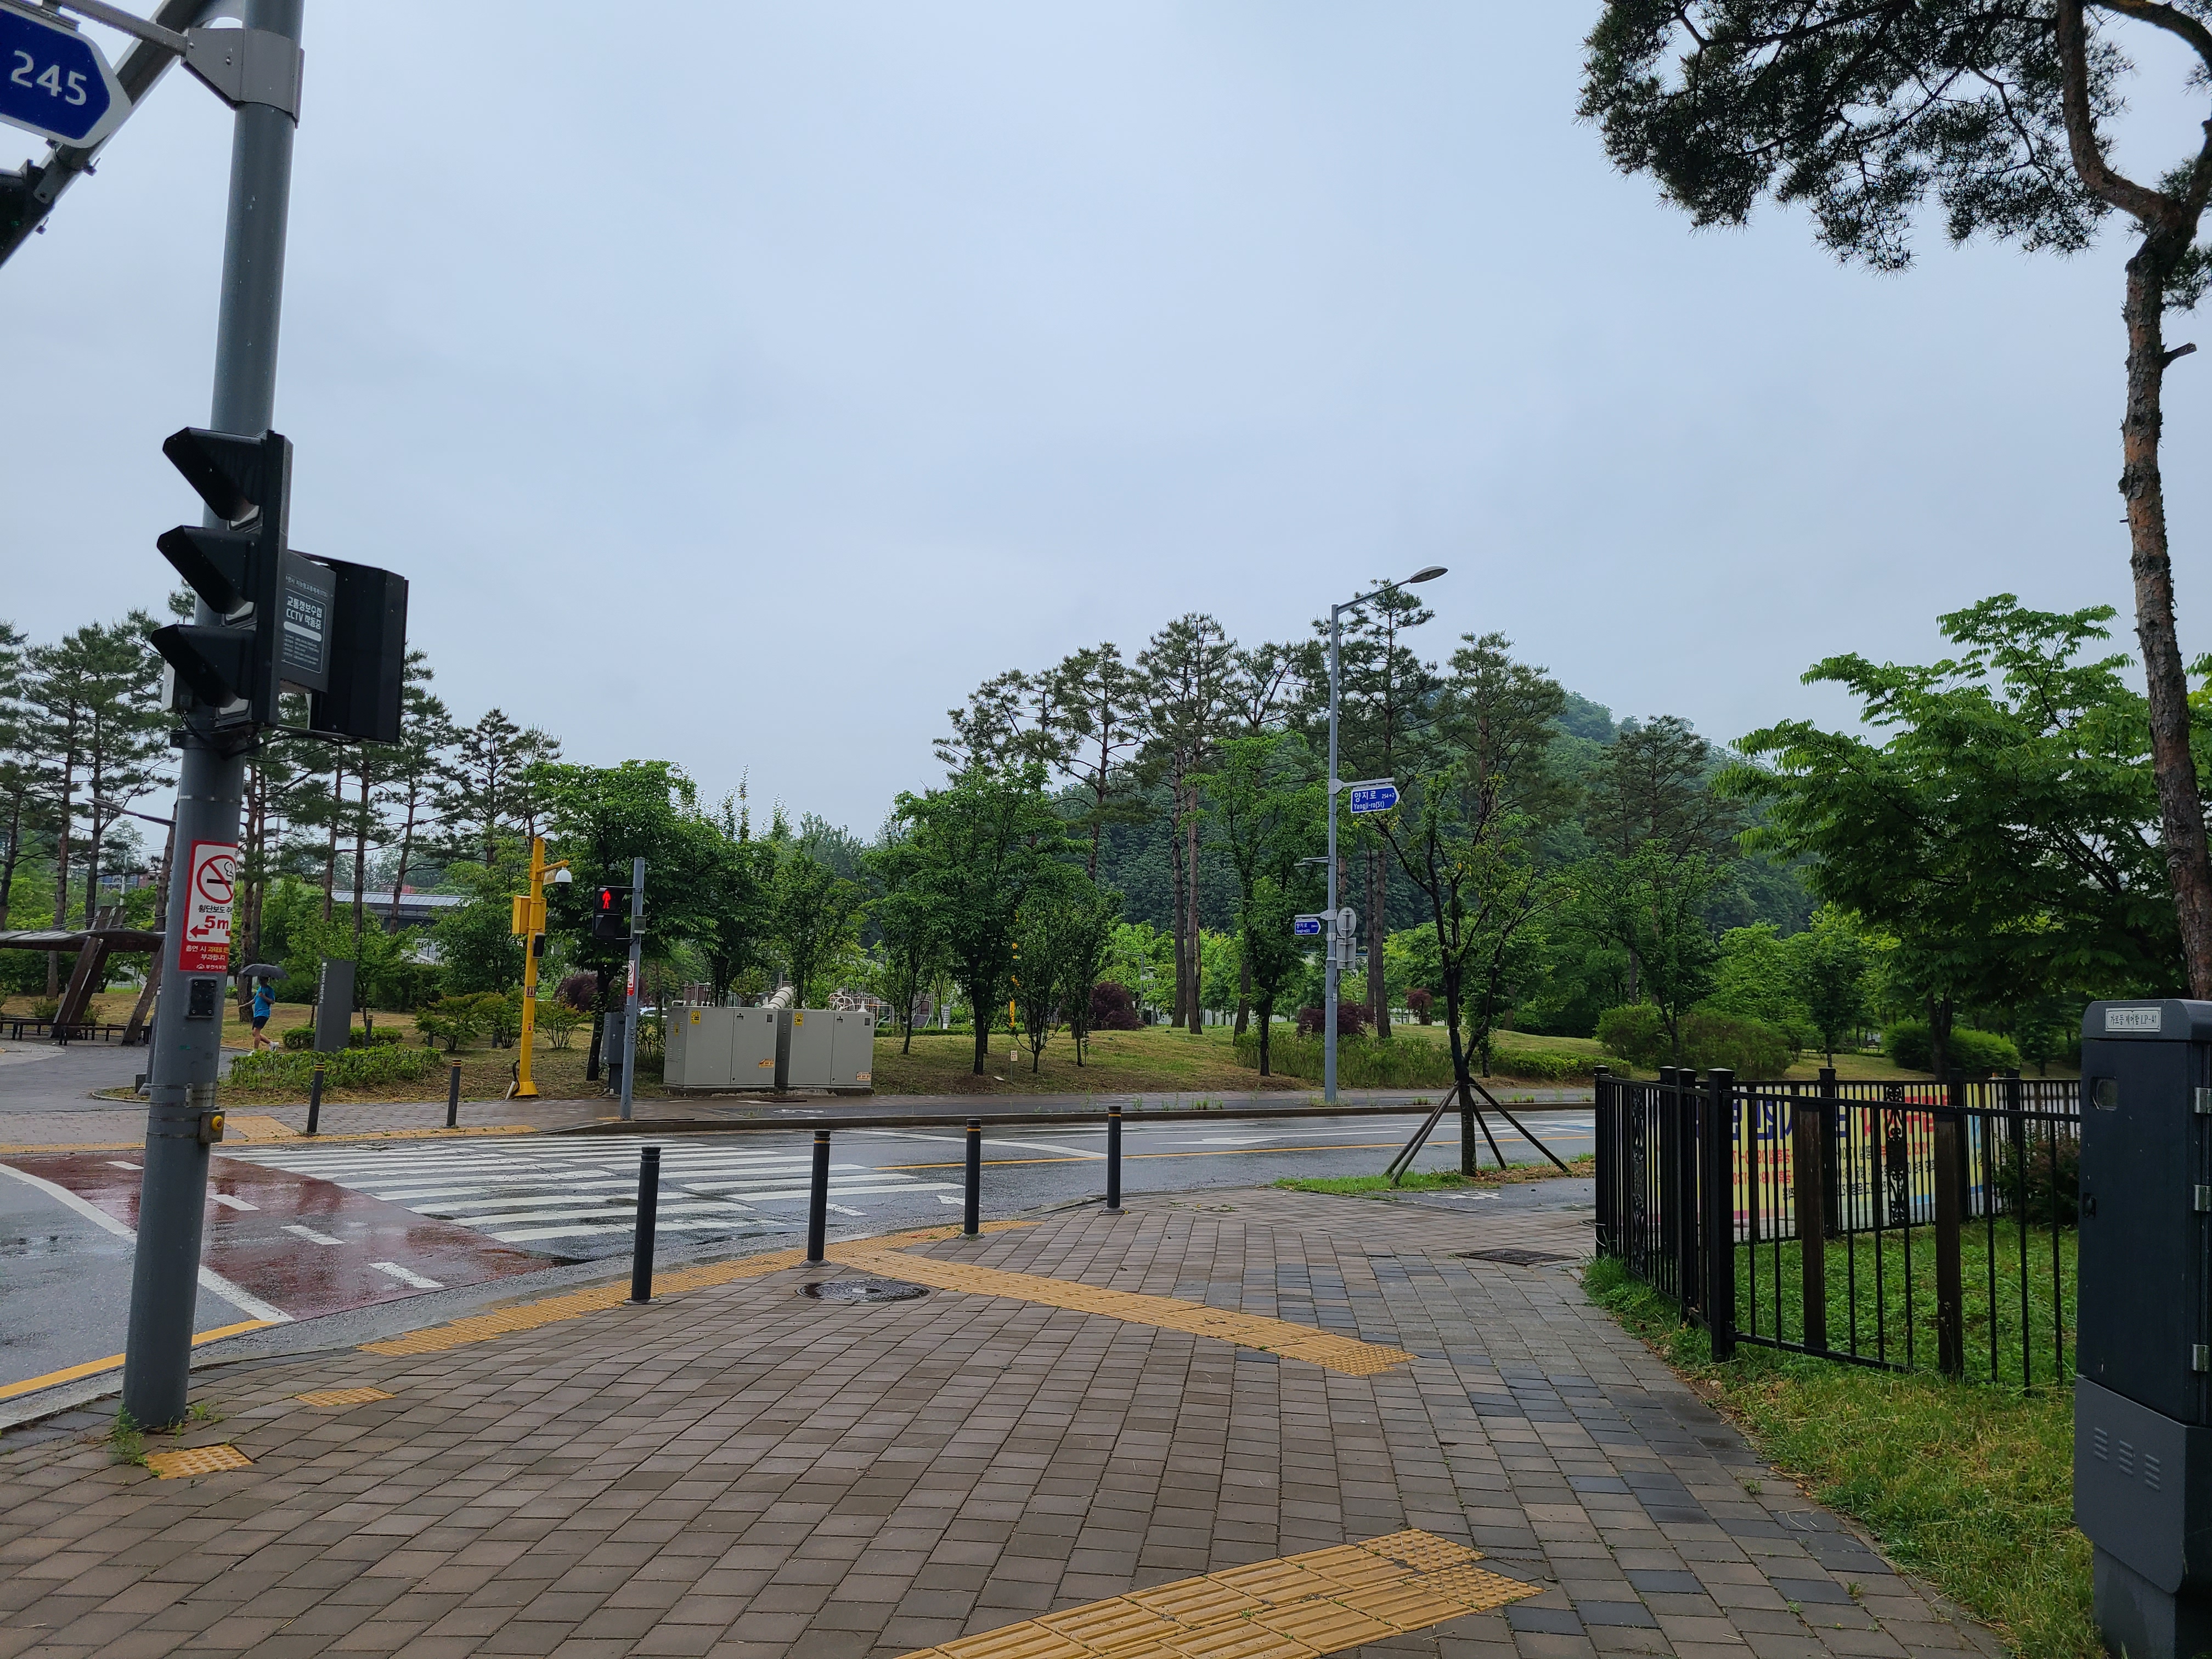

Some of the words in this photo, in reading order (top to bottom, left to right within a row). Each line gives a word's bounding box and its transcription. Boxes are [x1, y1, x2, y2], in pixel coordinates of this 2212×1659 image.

[11, 50, 87, 105] 245
[287, 596, 322, 618] 교통정보수집
[286, 608, 303, 622] CCTV
[304, 614, 321, 629] 작동중
[1354, 791, 1376, 803] 양지로
[198, 904, 225, 913] 횡단보도
[2110, 1014, 2125, 1026] 가로등
